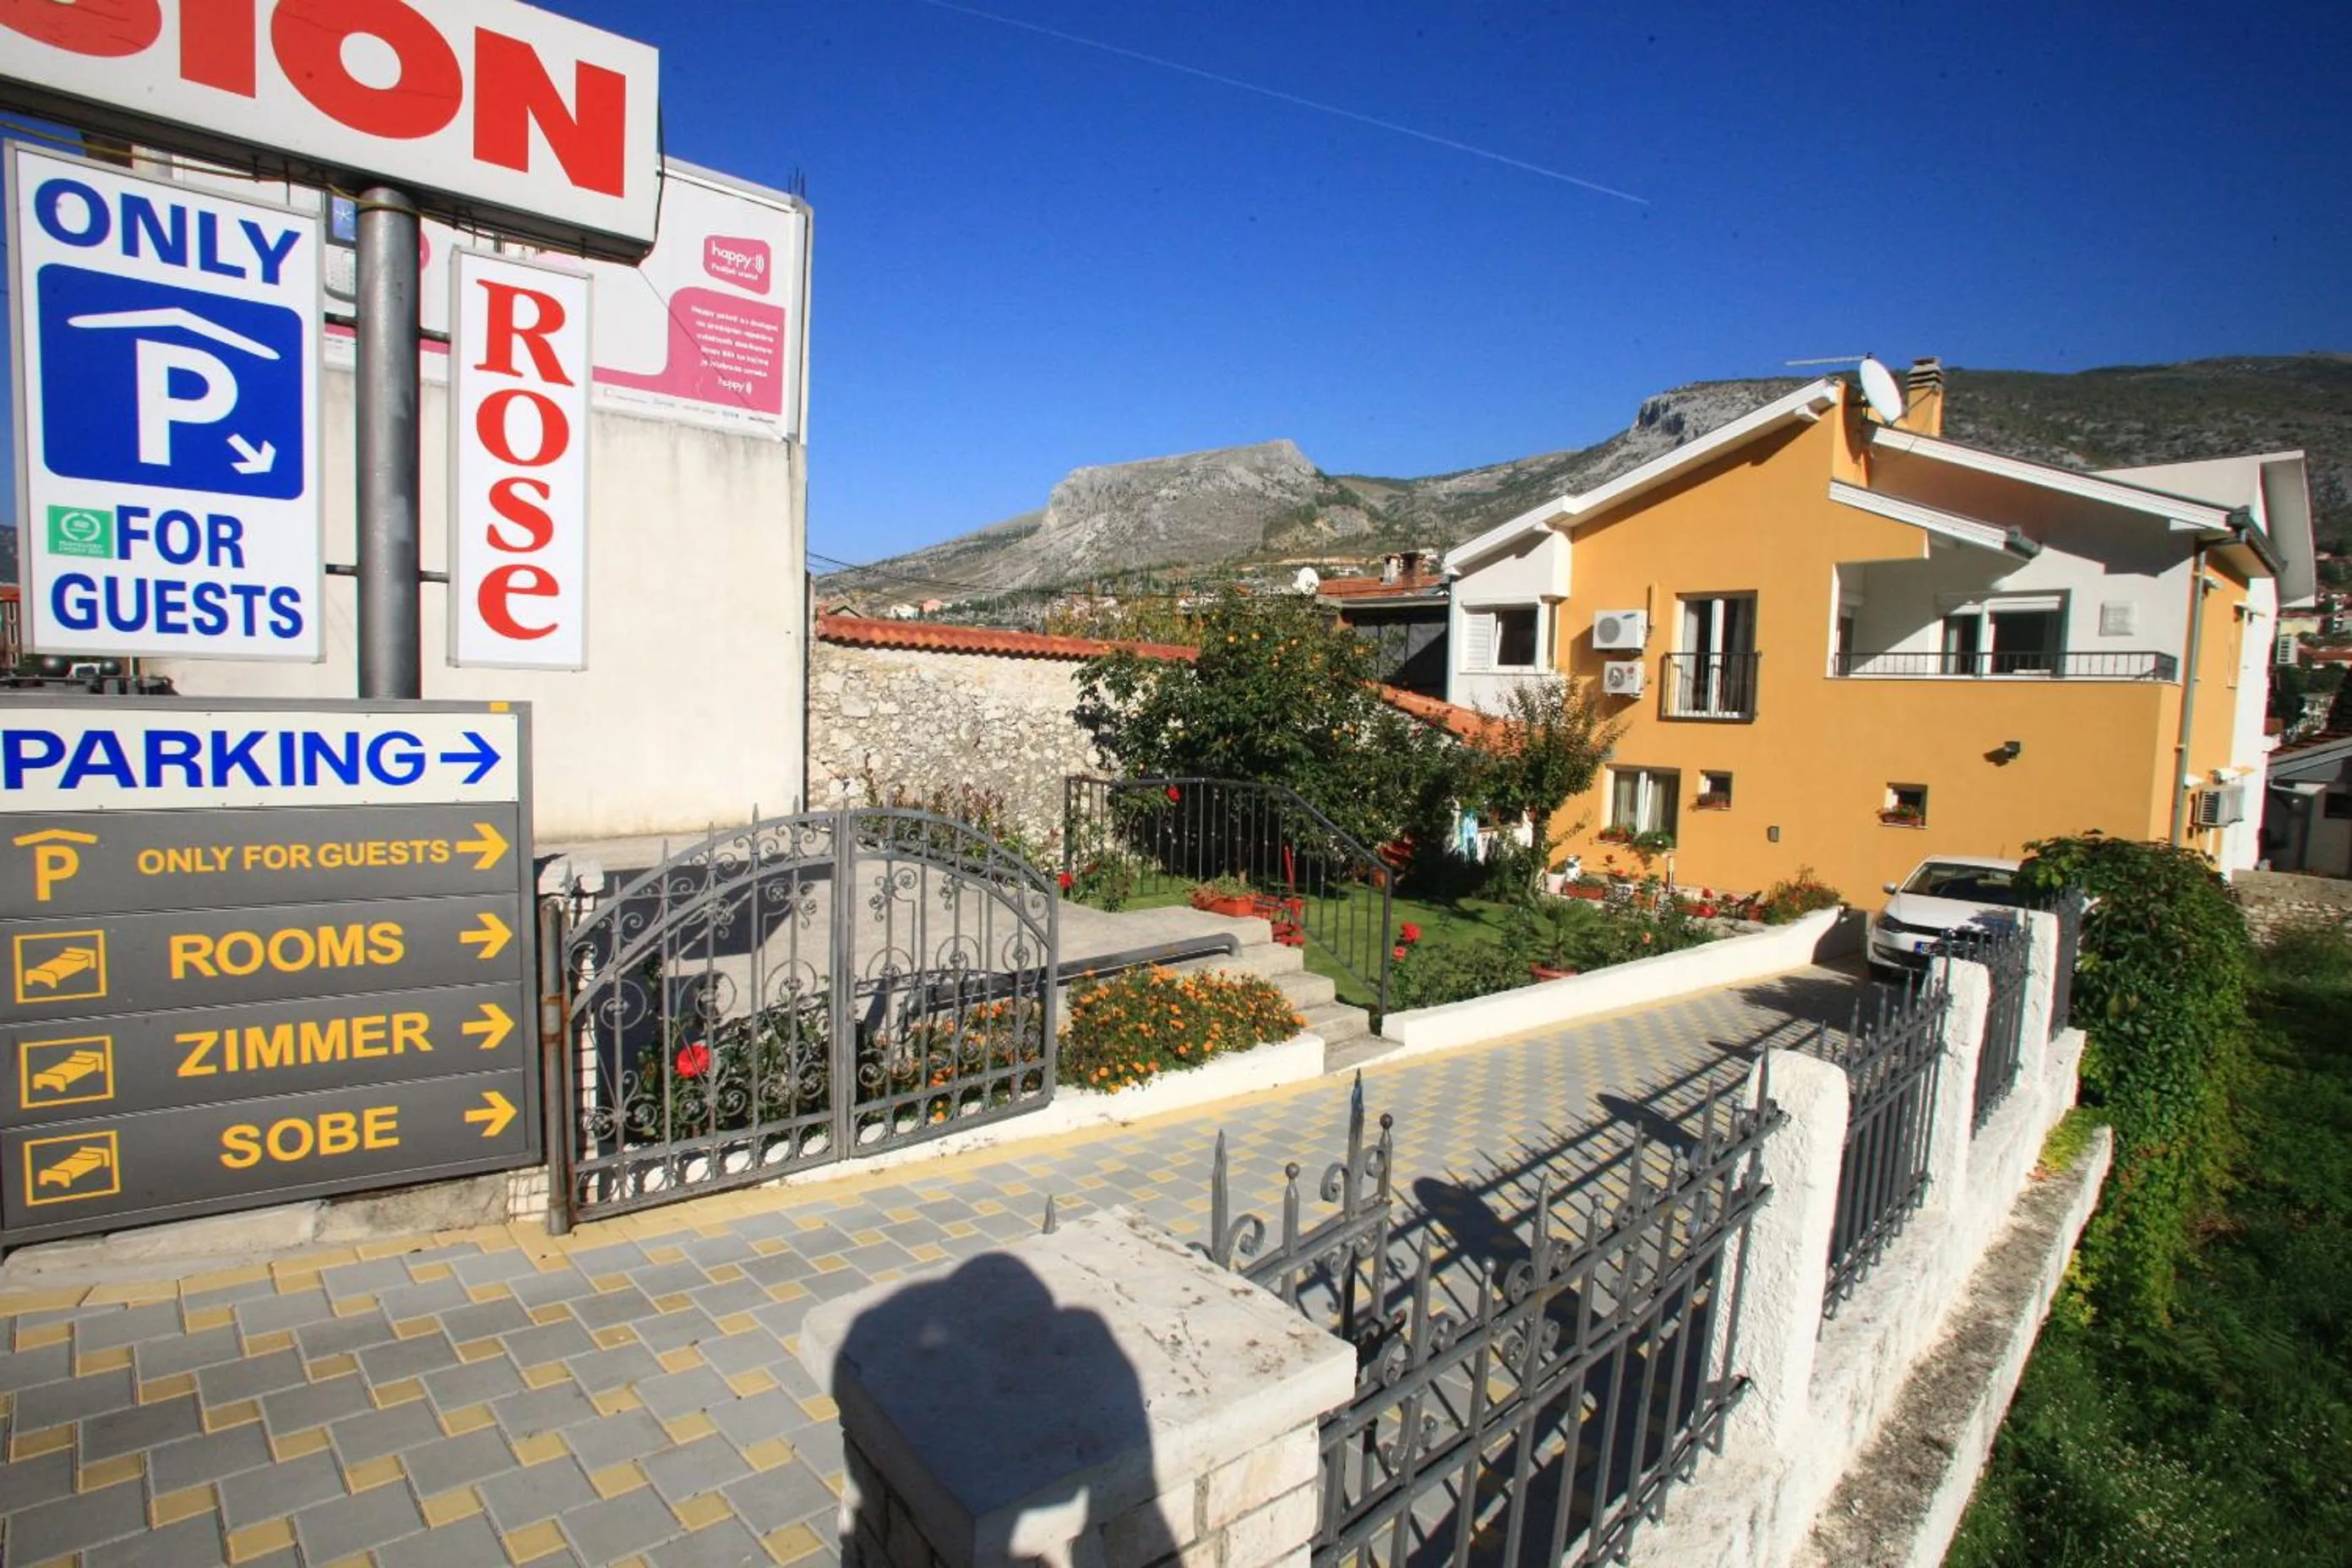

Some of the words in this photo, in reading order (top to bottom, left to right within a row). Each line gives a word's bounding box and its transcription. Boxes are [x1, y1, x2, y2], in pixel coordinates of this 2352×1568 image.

[35, 178, 302, 286] ONLY
[135, 337, 239, 466] P
[474, 279, 574, 640] Rose
[117, 504, 244, 569] FOR
[52, 573, 302, 639] GUESTS
[3, 730, 426, 790] PARKING
[35, 847, 79, 901] P
[137, 846, 234, 875] ONLY
[243, 842, 313, 870] FOR
[318, 839, 450, 869] GUESTS
[169, 921, 405, 980] ROOMS
[175, 1011, 433, 1078] ZIMMER
[219, 1105, 400, 1169] SOBE
